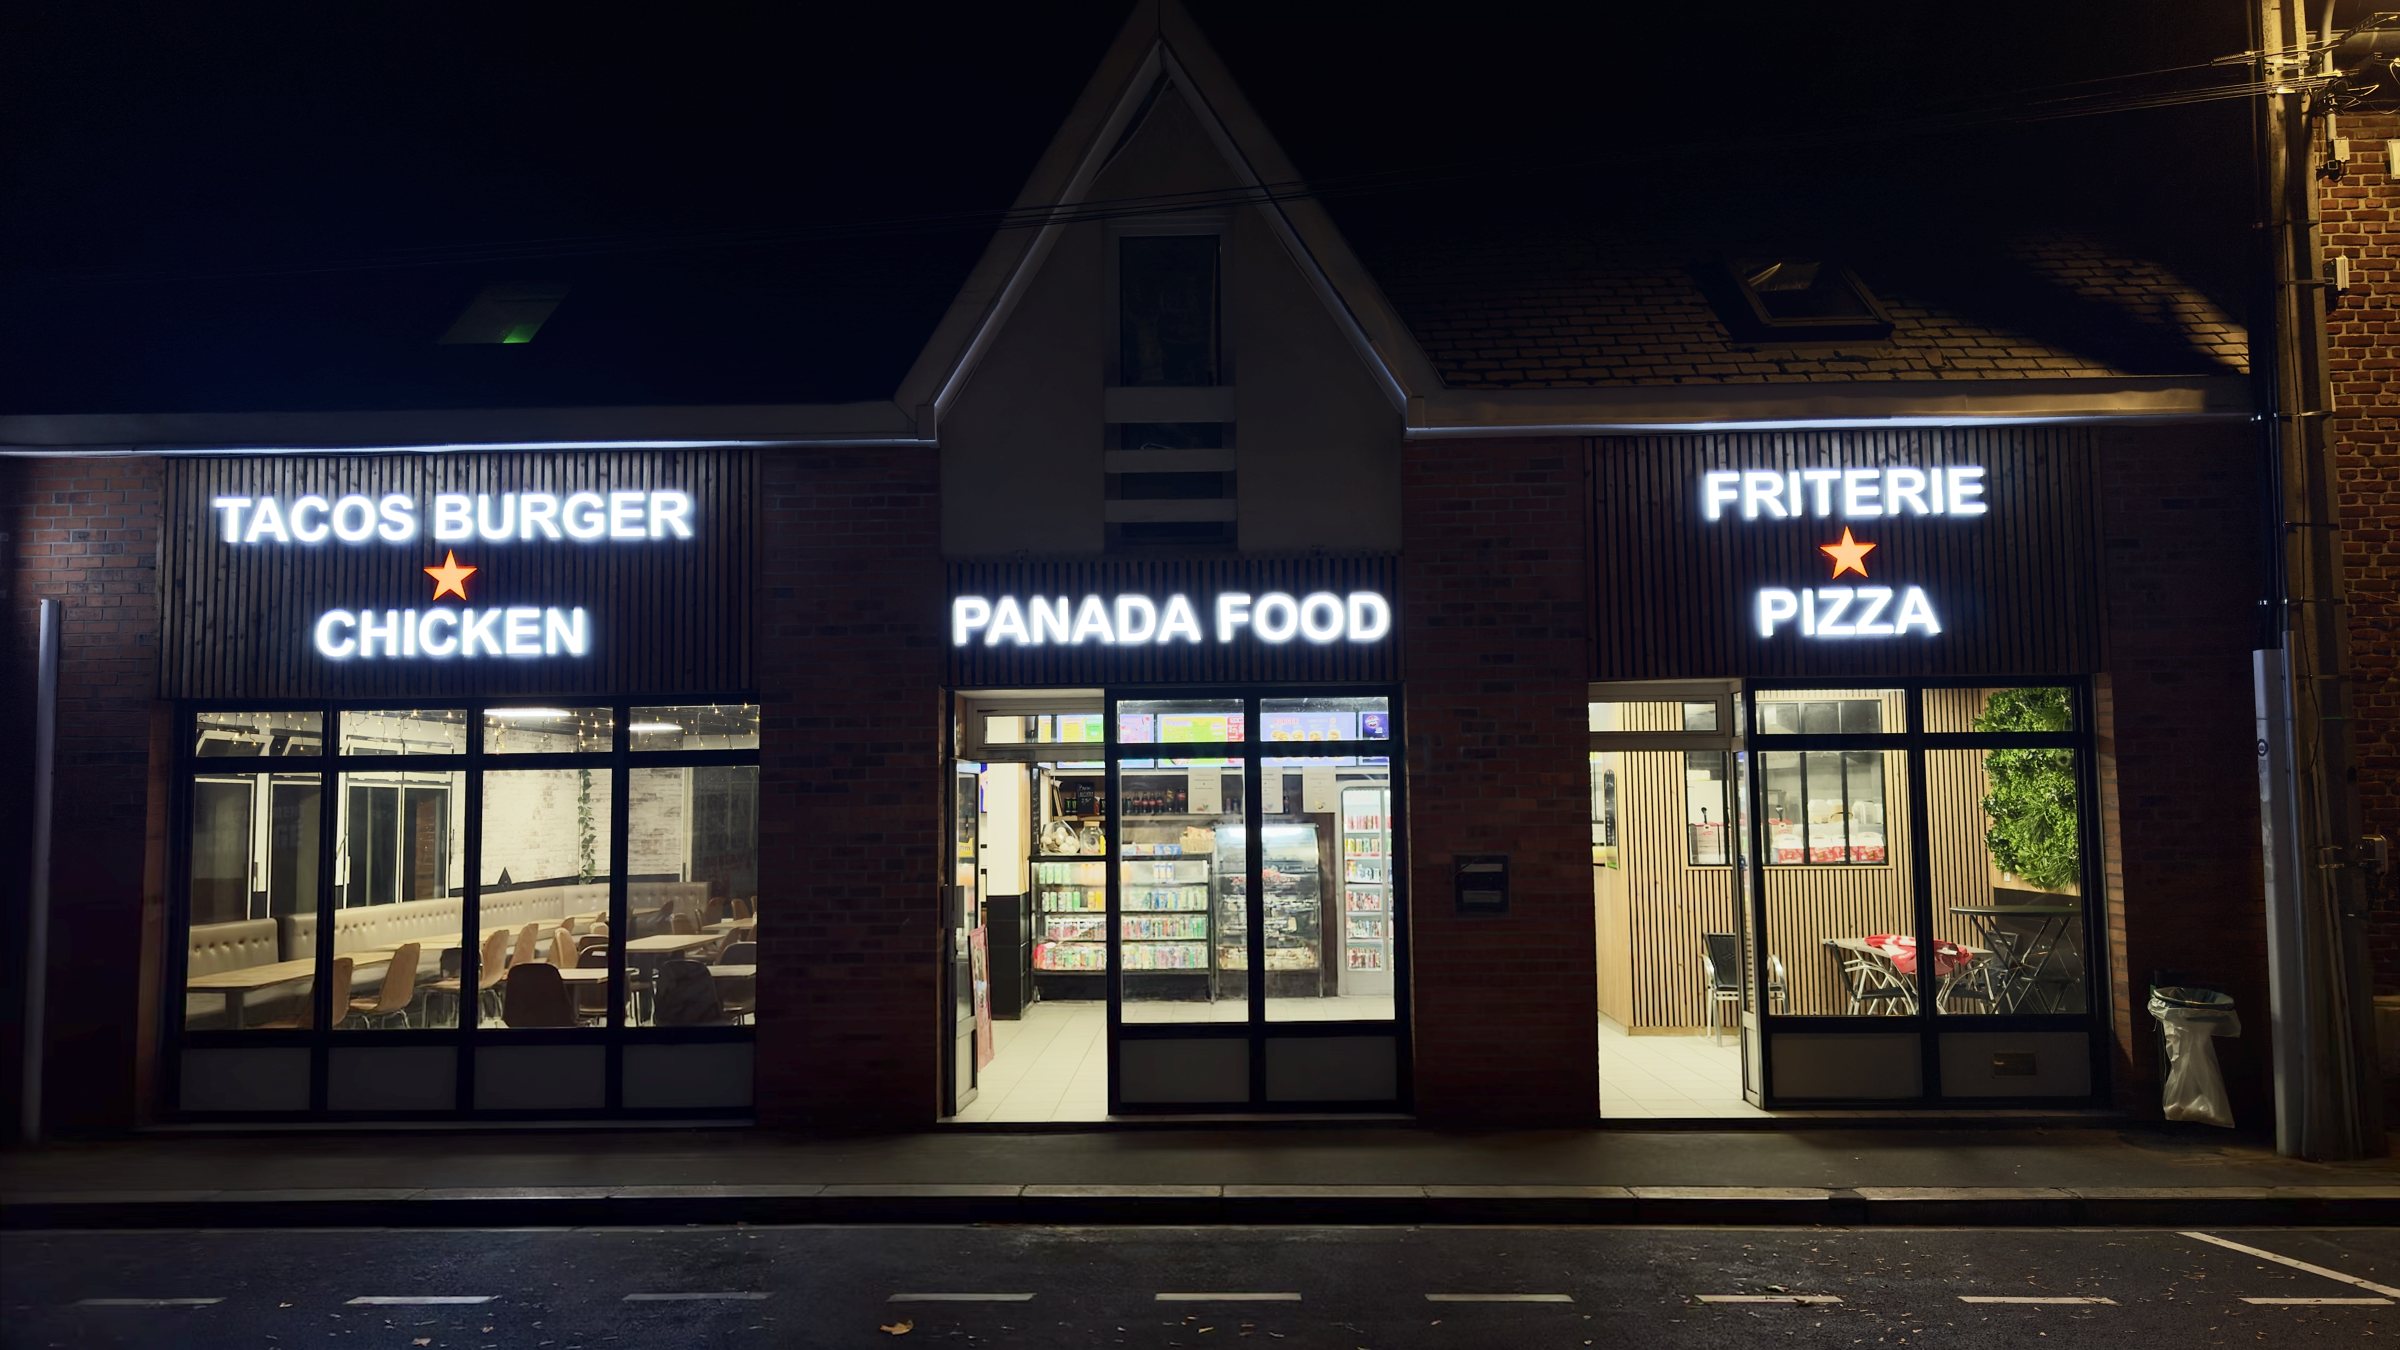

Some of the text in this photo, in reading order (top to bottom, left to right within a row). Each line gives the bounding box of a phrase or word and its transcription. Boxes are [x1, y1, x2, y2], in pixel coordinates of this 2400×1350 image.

[212, 488, 691, 543] TACOS BURGER
[1704, 466, 1986, 519] FRITERIE
[314, 607, 585, 658] CHICKEN
[953, 592, 1389, 645] PANADA FOOD
[1758, 586, 1940, 637] PIZZA
